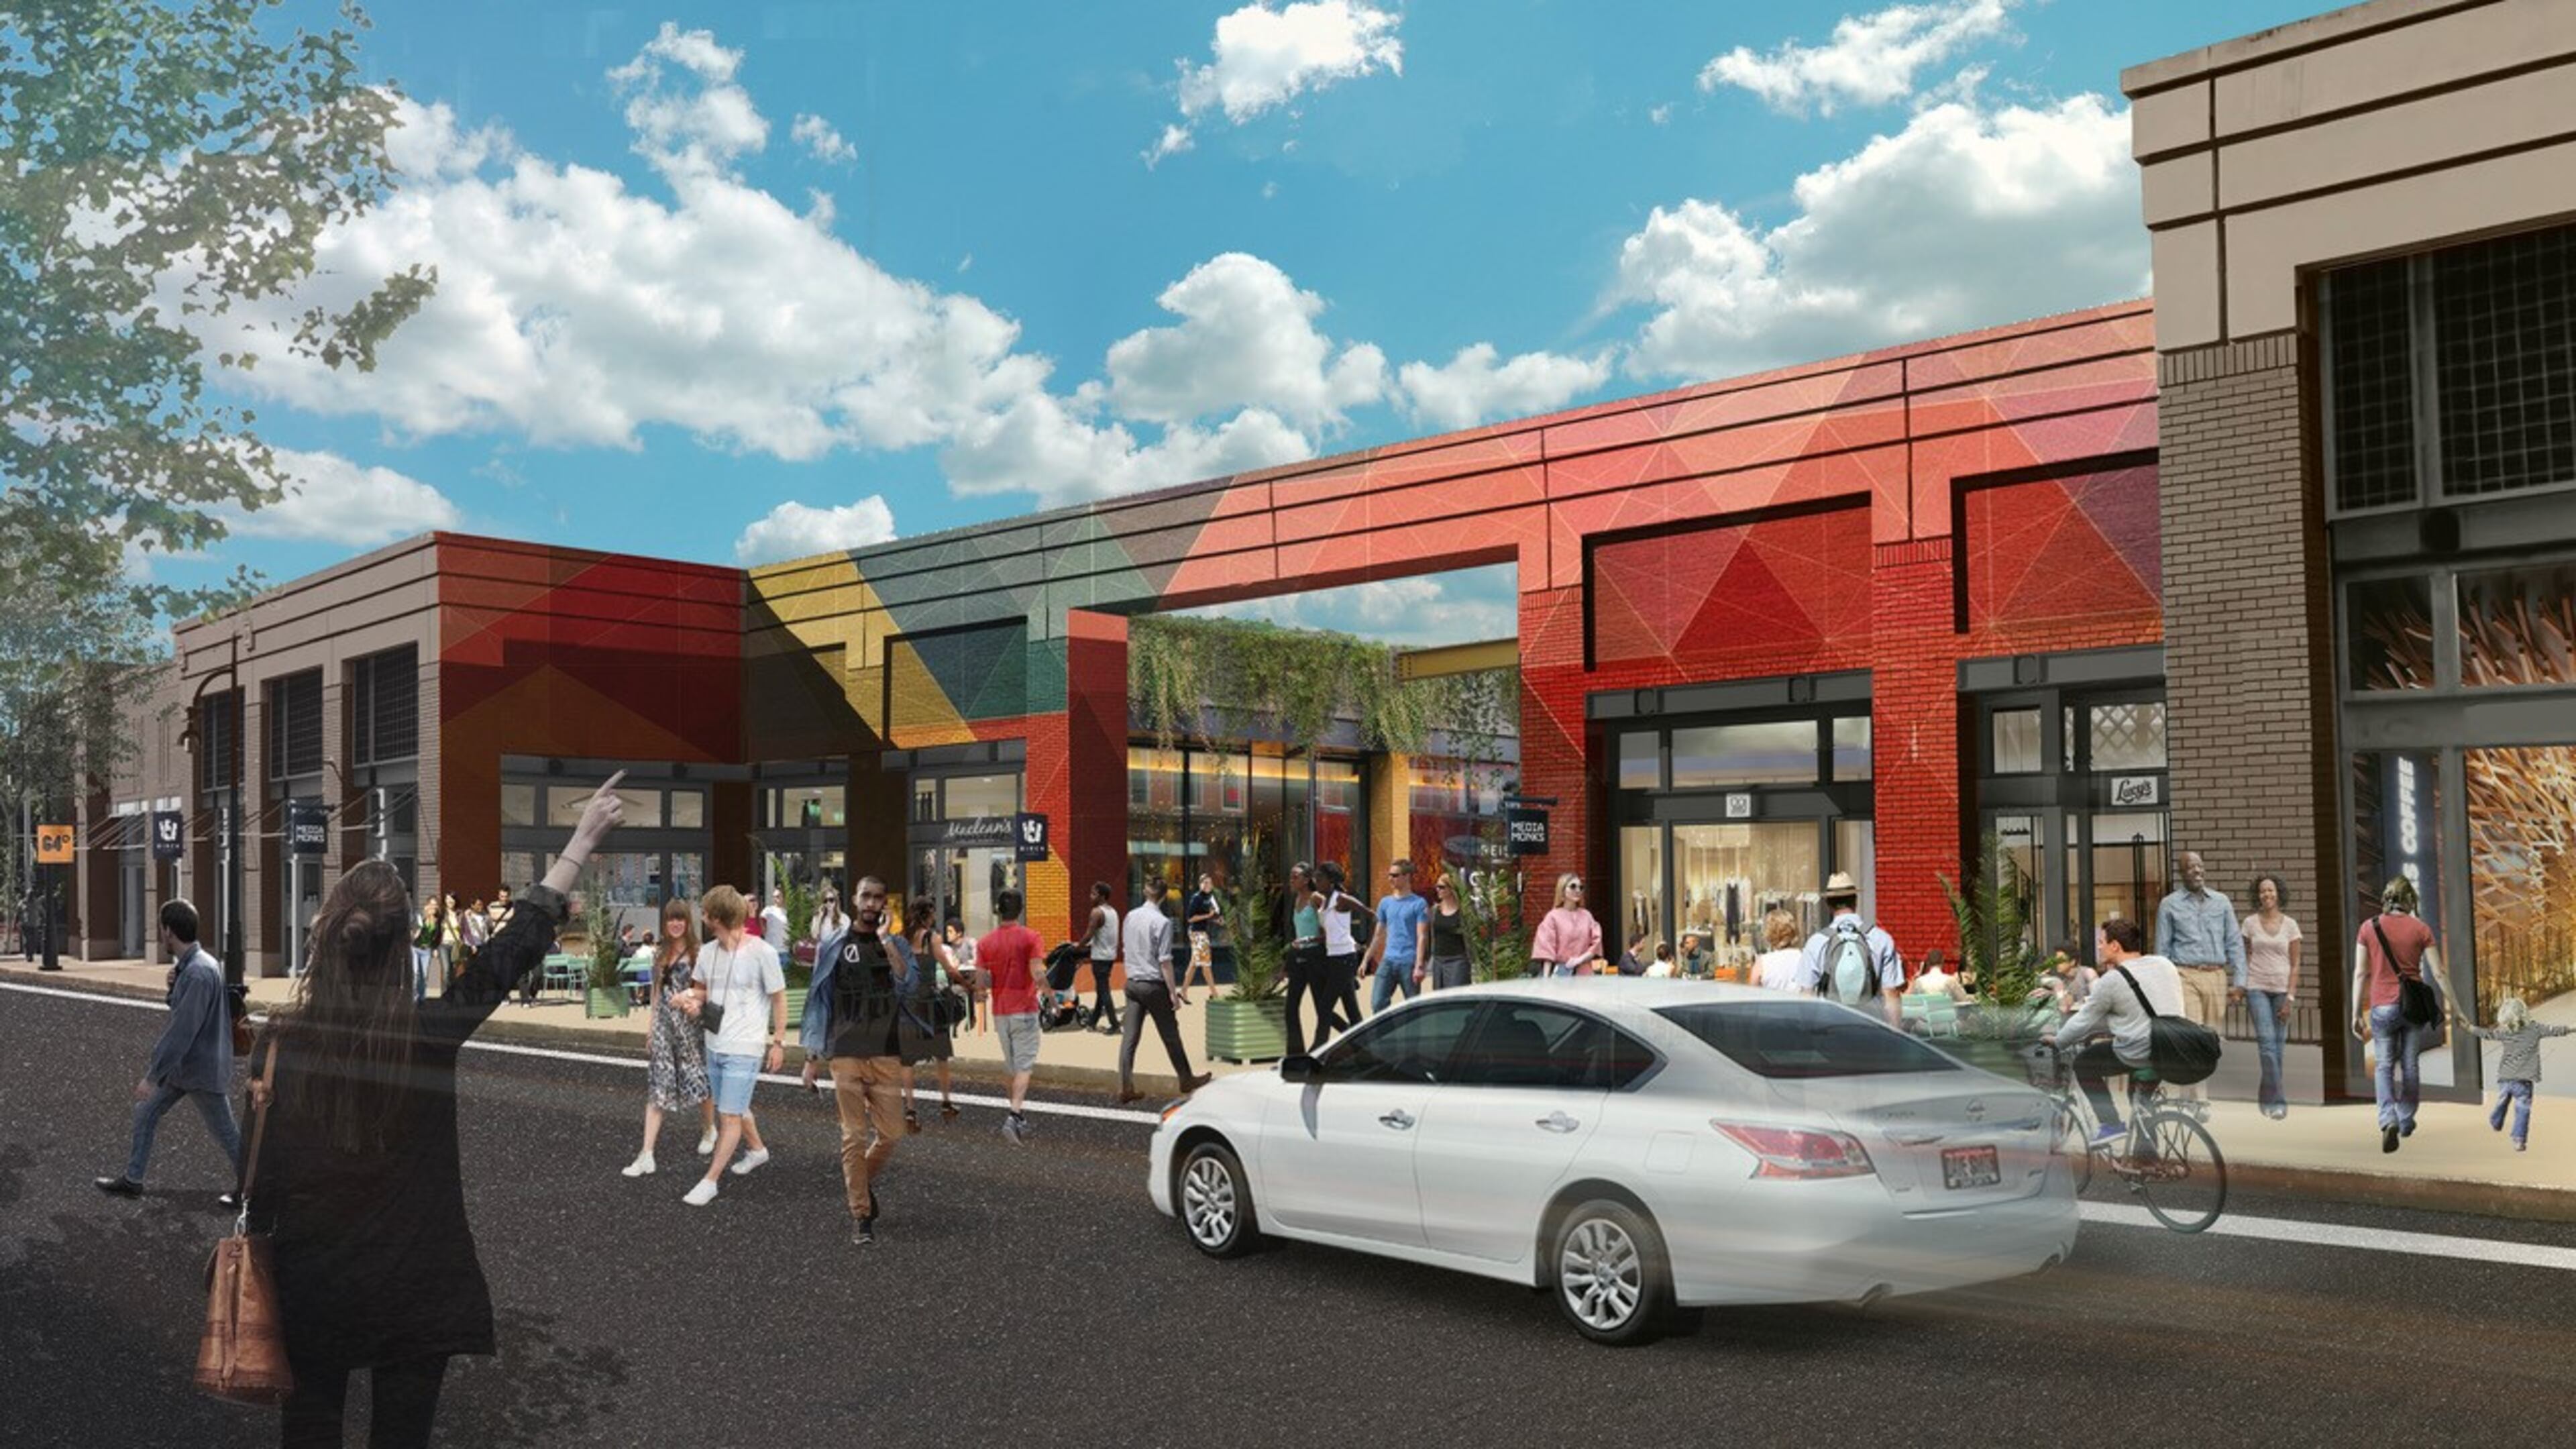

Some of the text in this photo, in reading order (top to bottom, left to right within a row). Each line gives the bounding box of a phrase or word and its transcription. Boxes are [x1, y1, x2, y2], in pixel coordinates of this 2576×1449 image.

[2398, 756, 2418, 855] COFFEE
[1511, 822, 1544, 832] MEDIA
[1511, 833, 1546, 842] MONKS
